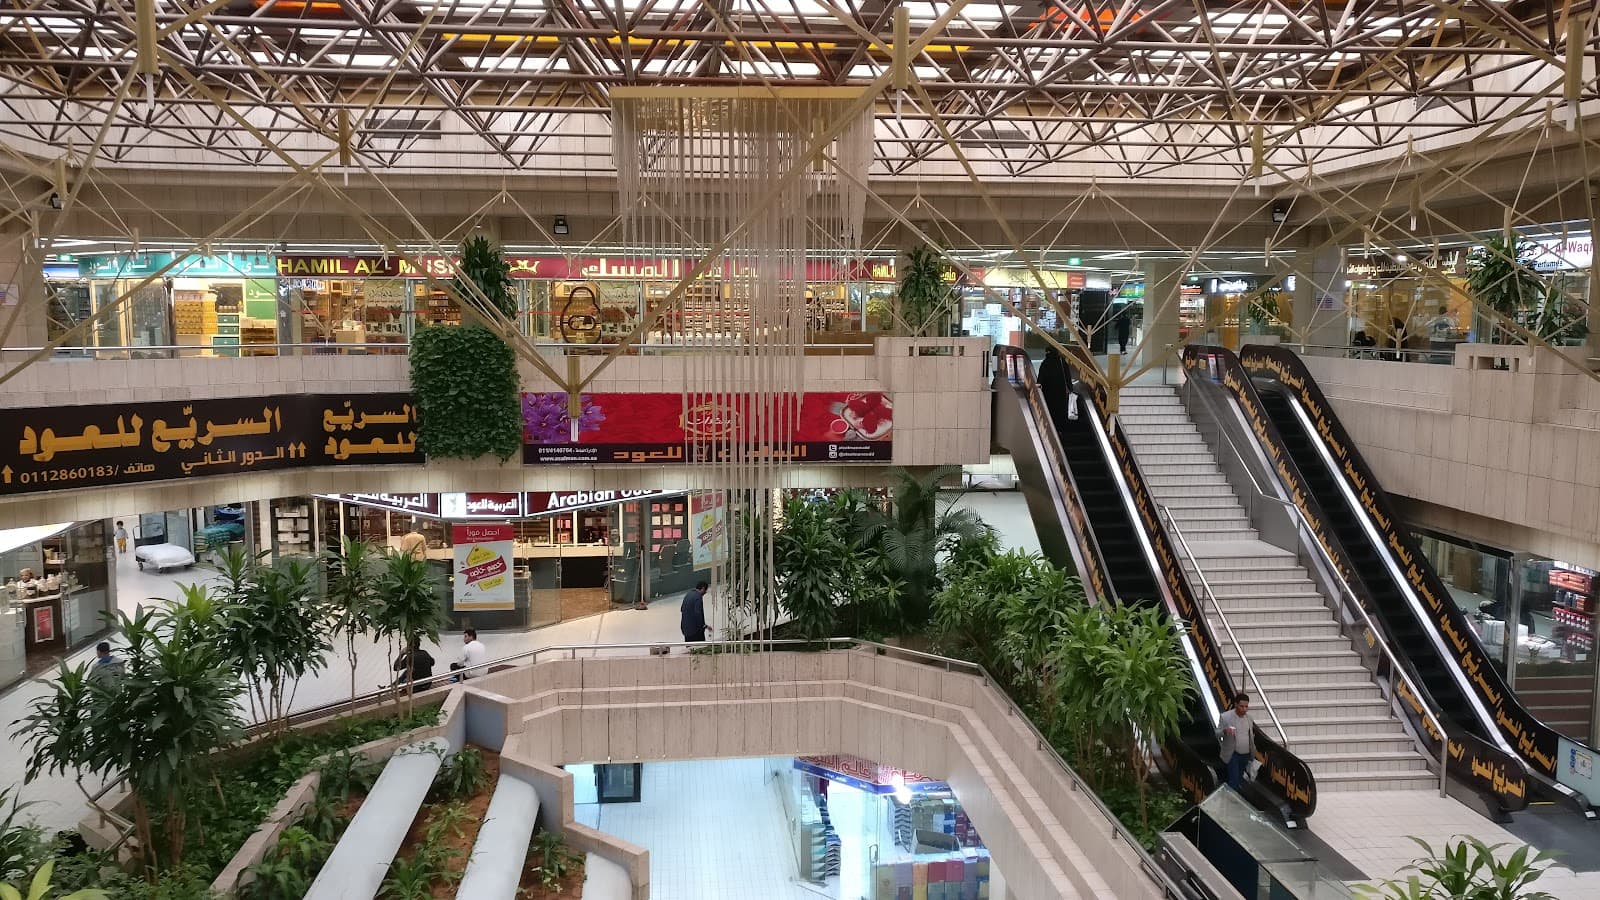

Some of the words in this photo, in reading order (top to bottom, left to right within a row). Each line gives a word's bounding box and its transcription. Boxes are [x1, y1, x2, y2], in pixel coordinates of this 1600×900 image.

[277, 259, 349, 274] HAMIL
[19, 412, 143, 462] للعود
[324, 430, 417, 460] للعود
[181, 448, 236, 474] الثاني
[240, 446, 284, 466] الدور
[614, 446, 682, 462] للعود
[123, 462, 156, 474] هاتف
[466, 498, 489, 513] للعود
[547, 490, 615, 509] Arabian
